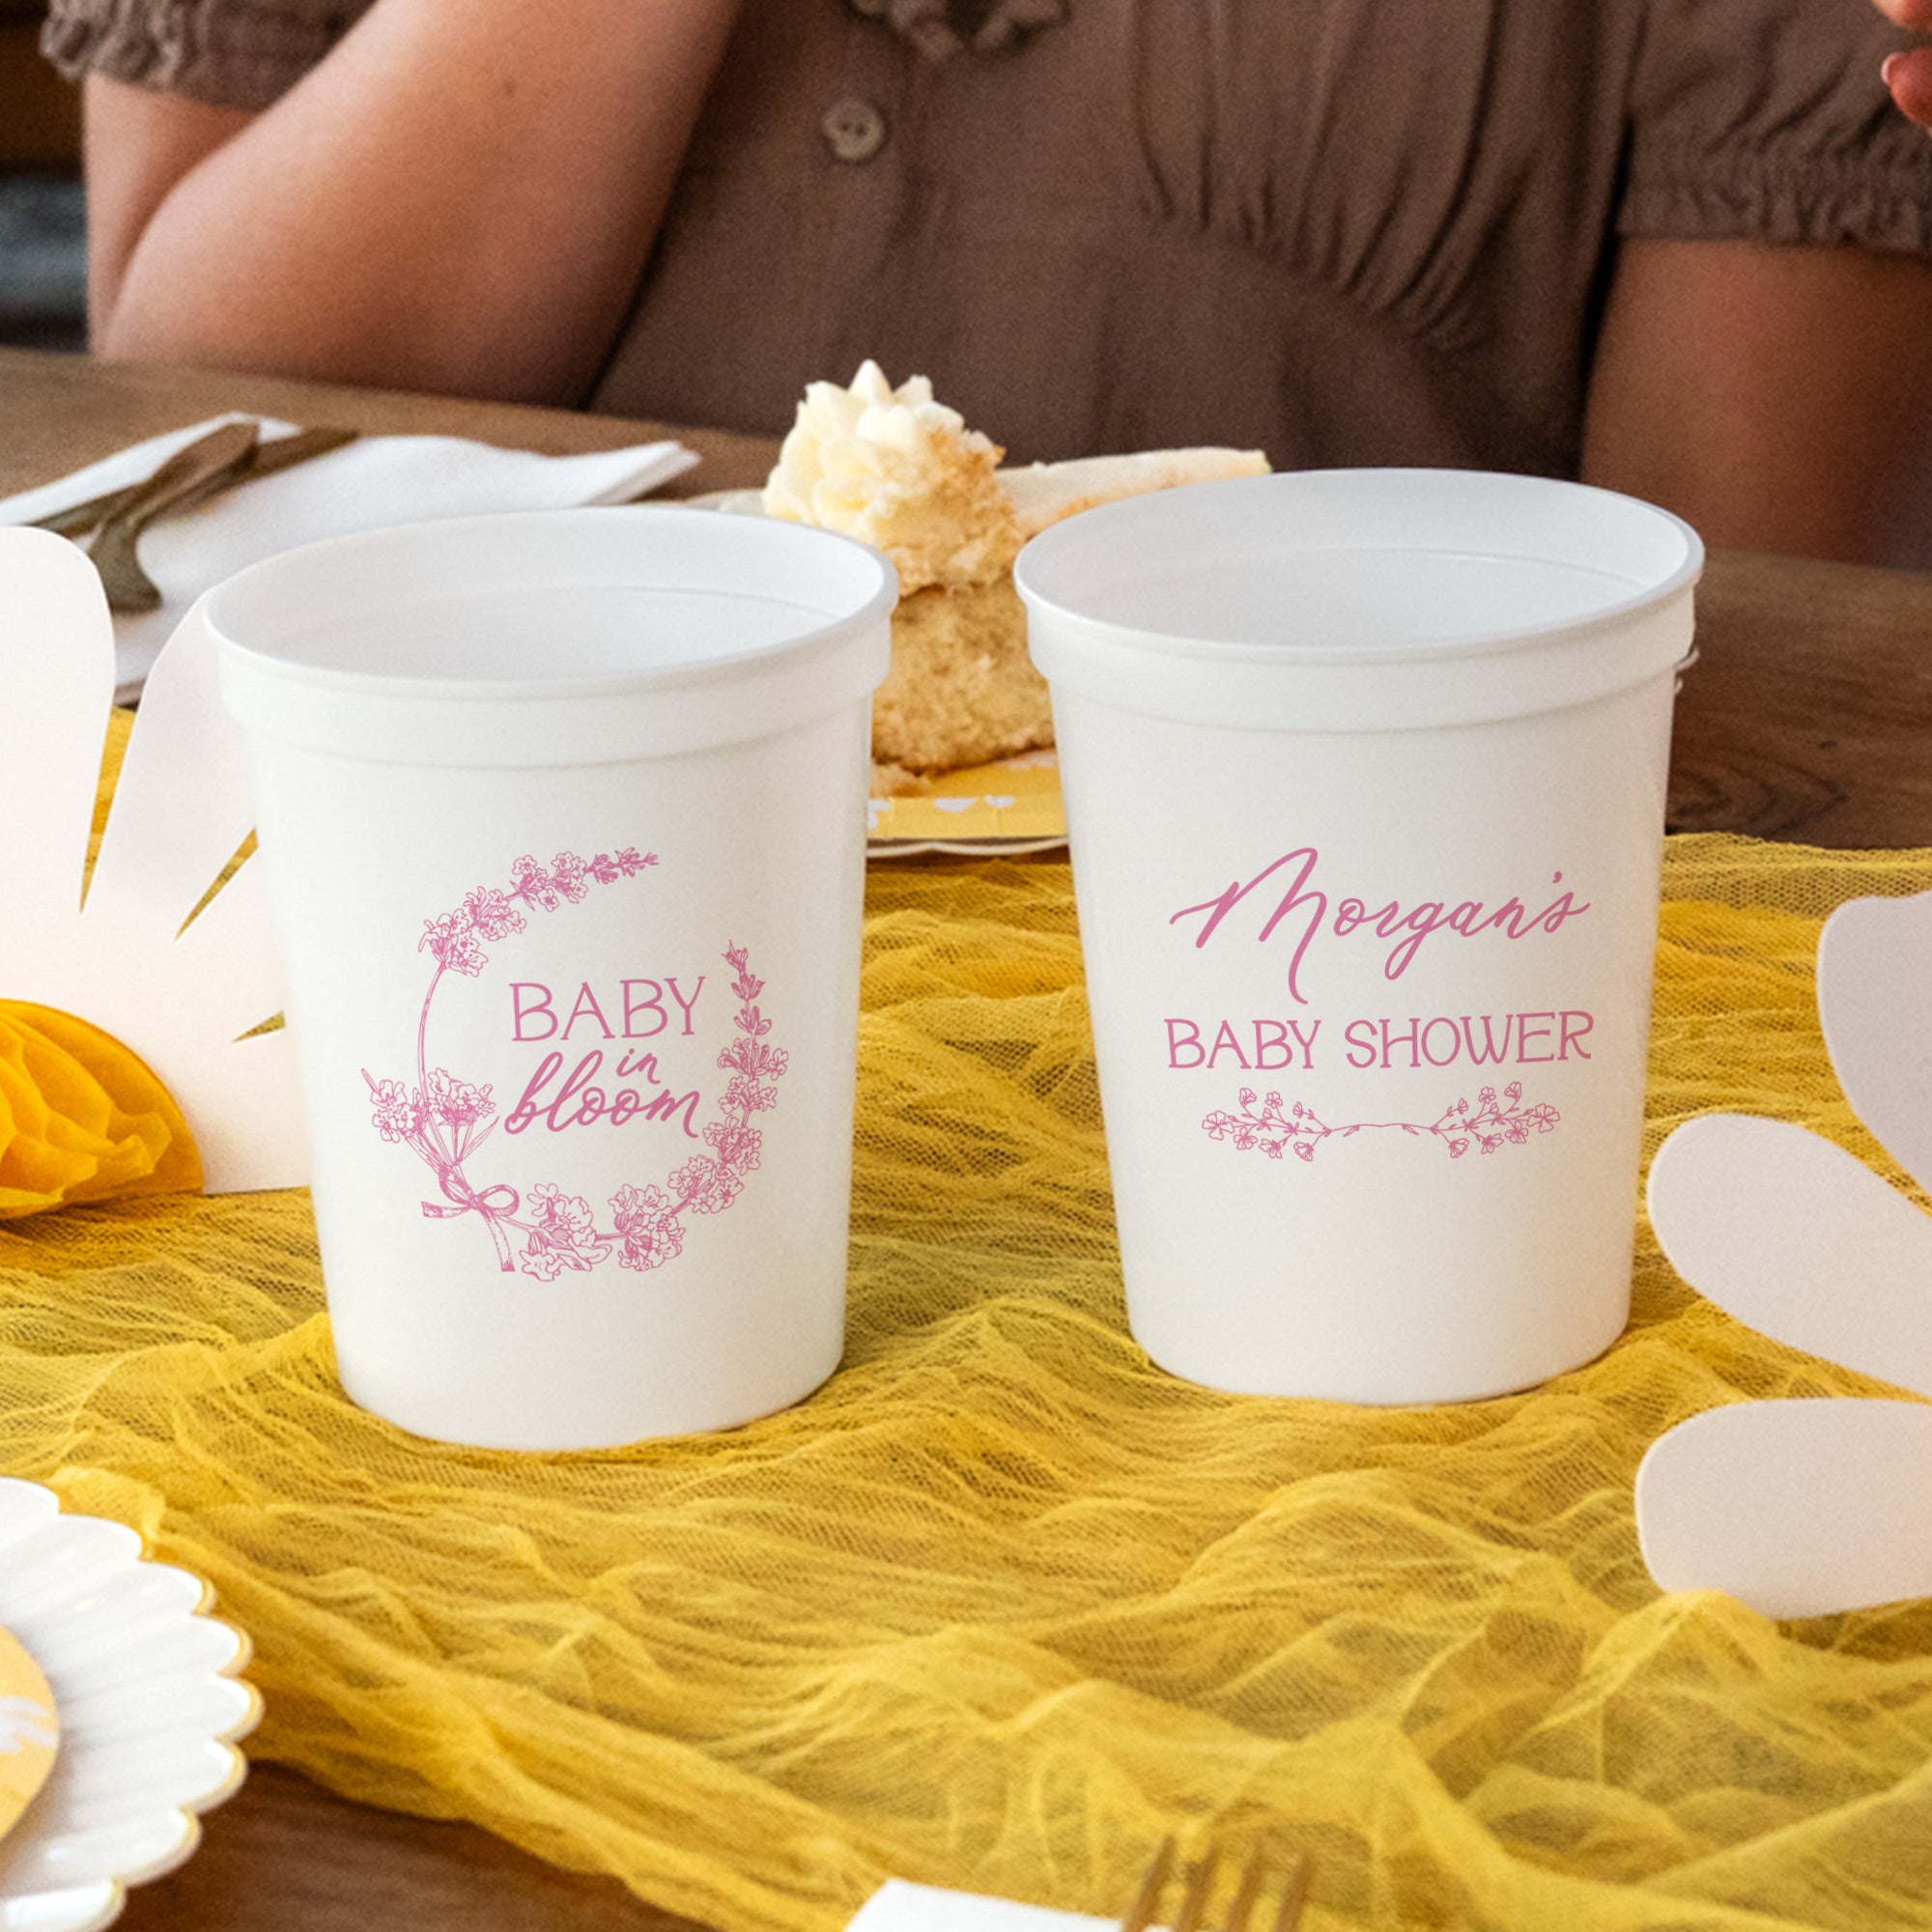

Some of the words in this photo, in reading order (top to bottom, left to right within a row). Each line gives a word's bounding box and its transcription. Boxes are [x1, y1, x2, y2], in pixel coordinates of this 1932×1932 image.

[1169, 847, 1591, 1005] Morgan's
[509, 976, 706, 1042] BABY
[1164, 1018, 1322, 1070] BABY
[1344, 1010, 1594, 1069] SHOWER
[503, 1049, 700, 1139] bloom
[615, 1048, 661, 1085] in
